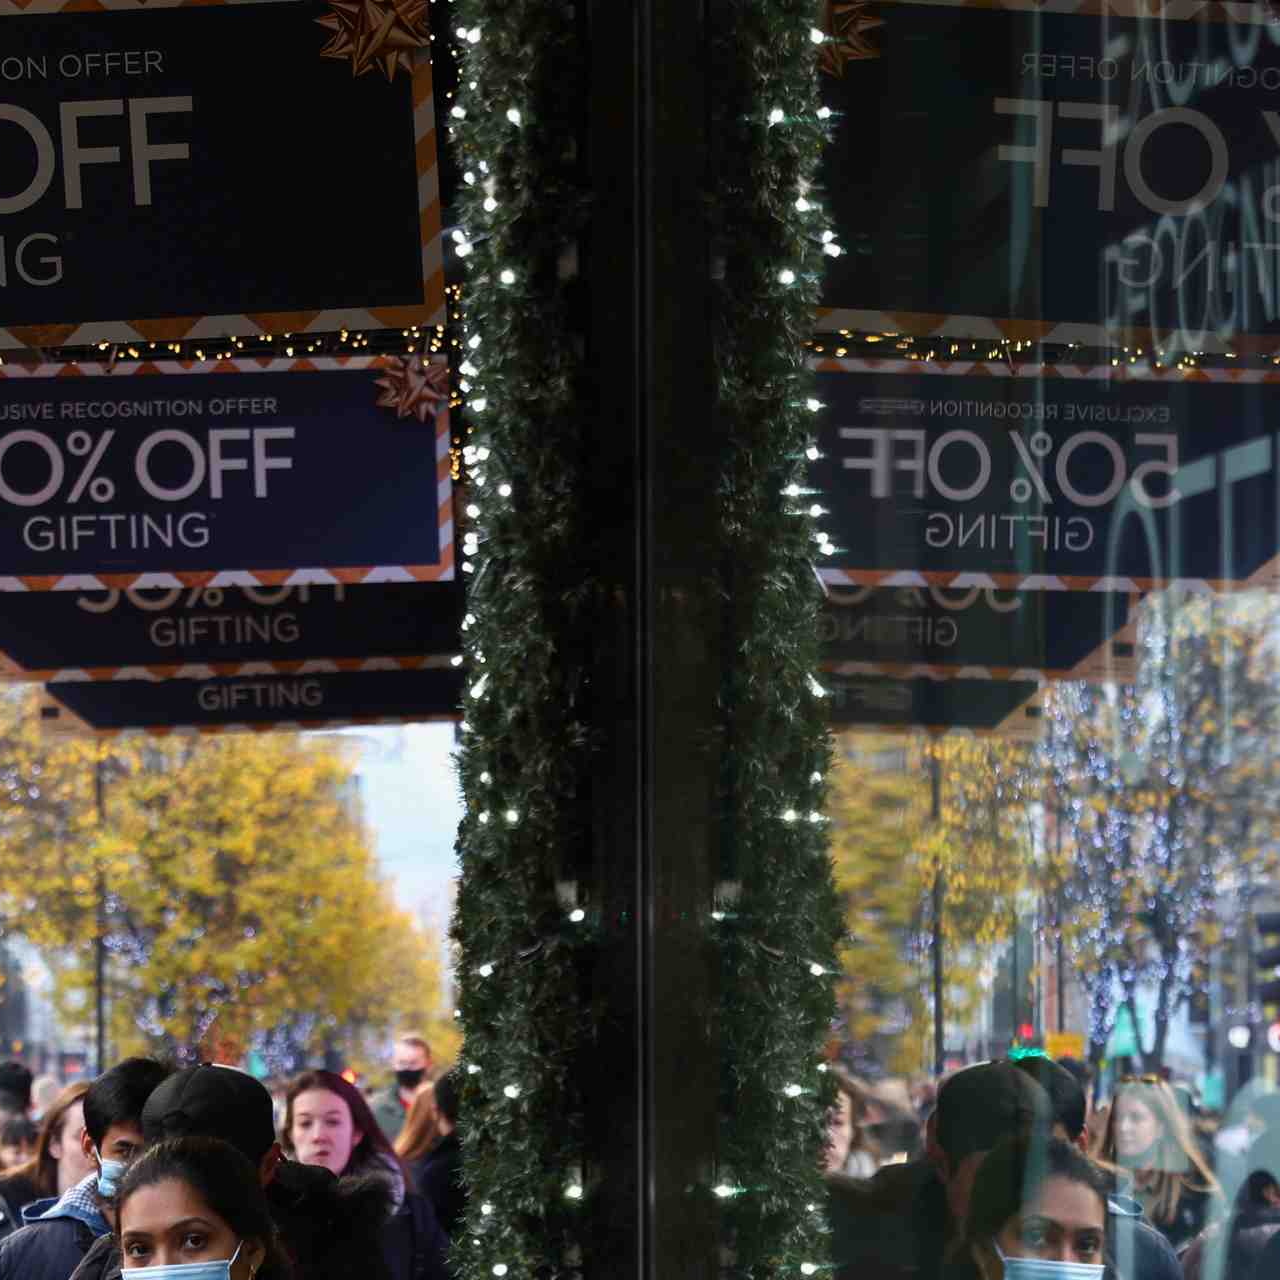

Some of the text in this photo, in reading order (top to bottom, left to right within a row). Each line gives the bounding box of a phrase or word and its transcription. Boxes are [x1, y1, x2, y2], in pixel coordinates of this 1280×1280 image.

[59, 49, 165, 79] OFFER
[60, 398, 205, 420] RECOGNITION
[208, 397, 278, 416] OFFER
[135, 427, 297, 502] OFF
[22, 511, 211, 552] GIFTING
[149, 612, 301, 649] GIFTING
[197, 680, 325, 712] GIFTING
